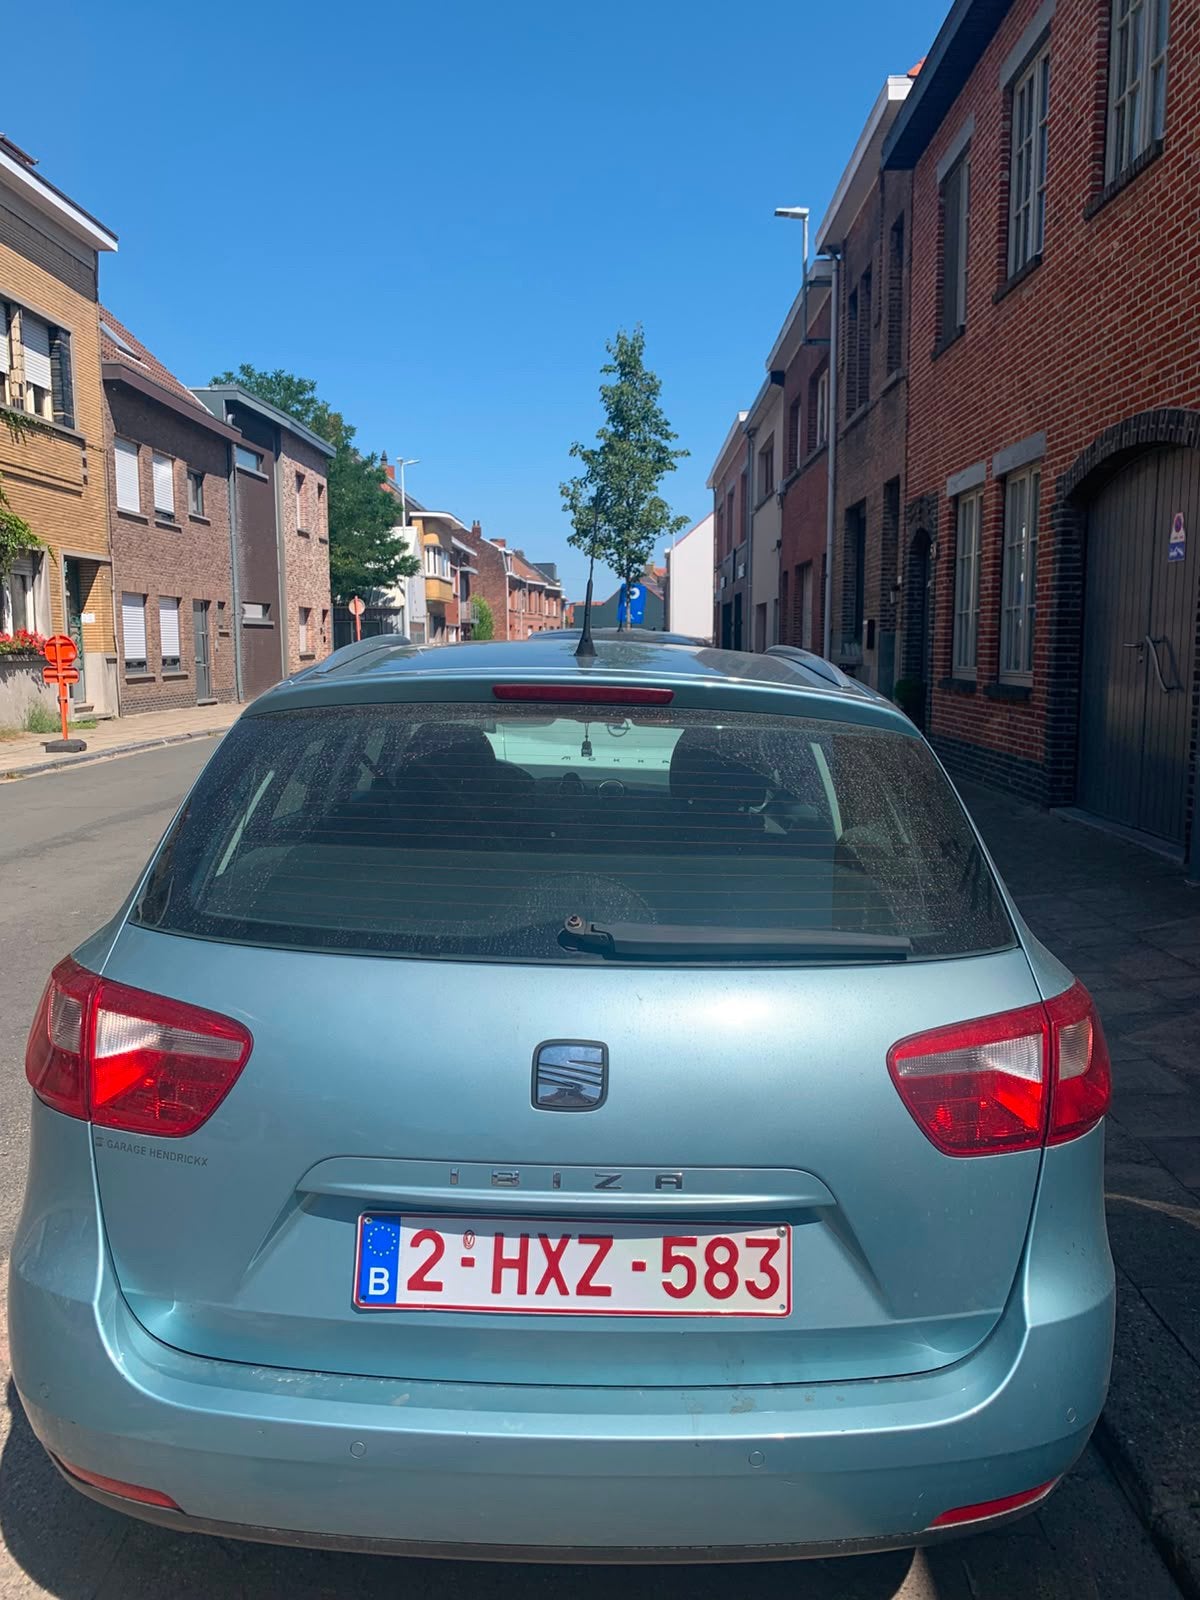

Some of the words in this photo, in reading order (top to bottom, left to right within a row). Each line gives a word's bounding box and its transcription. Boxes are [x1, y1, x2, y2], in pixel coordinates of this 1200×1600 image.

[106, 1139, 147, 1156] GARAGE
[149, 1148, 209, 1167] HENDRICKX
[449, 1168, 684, 1191] IBIZA
[368, 1267, 390, 1295] B
